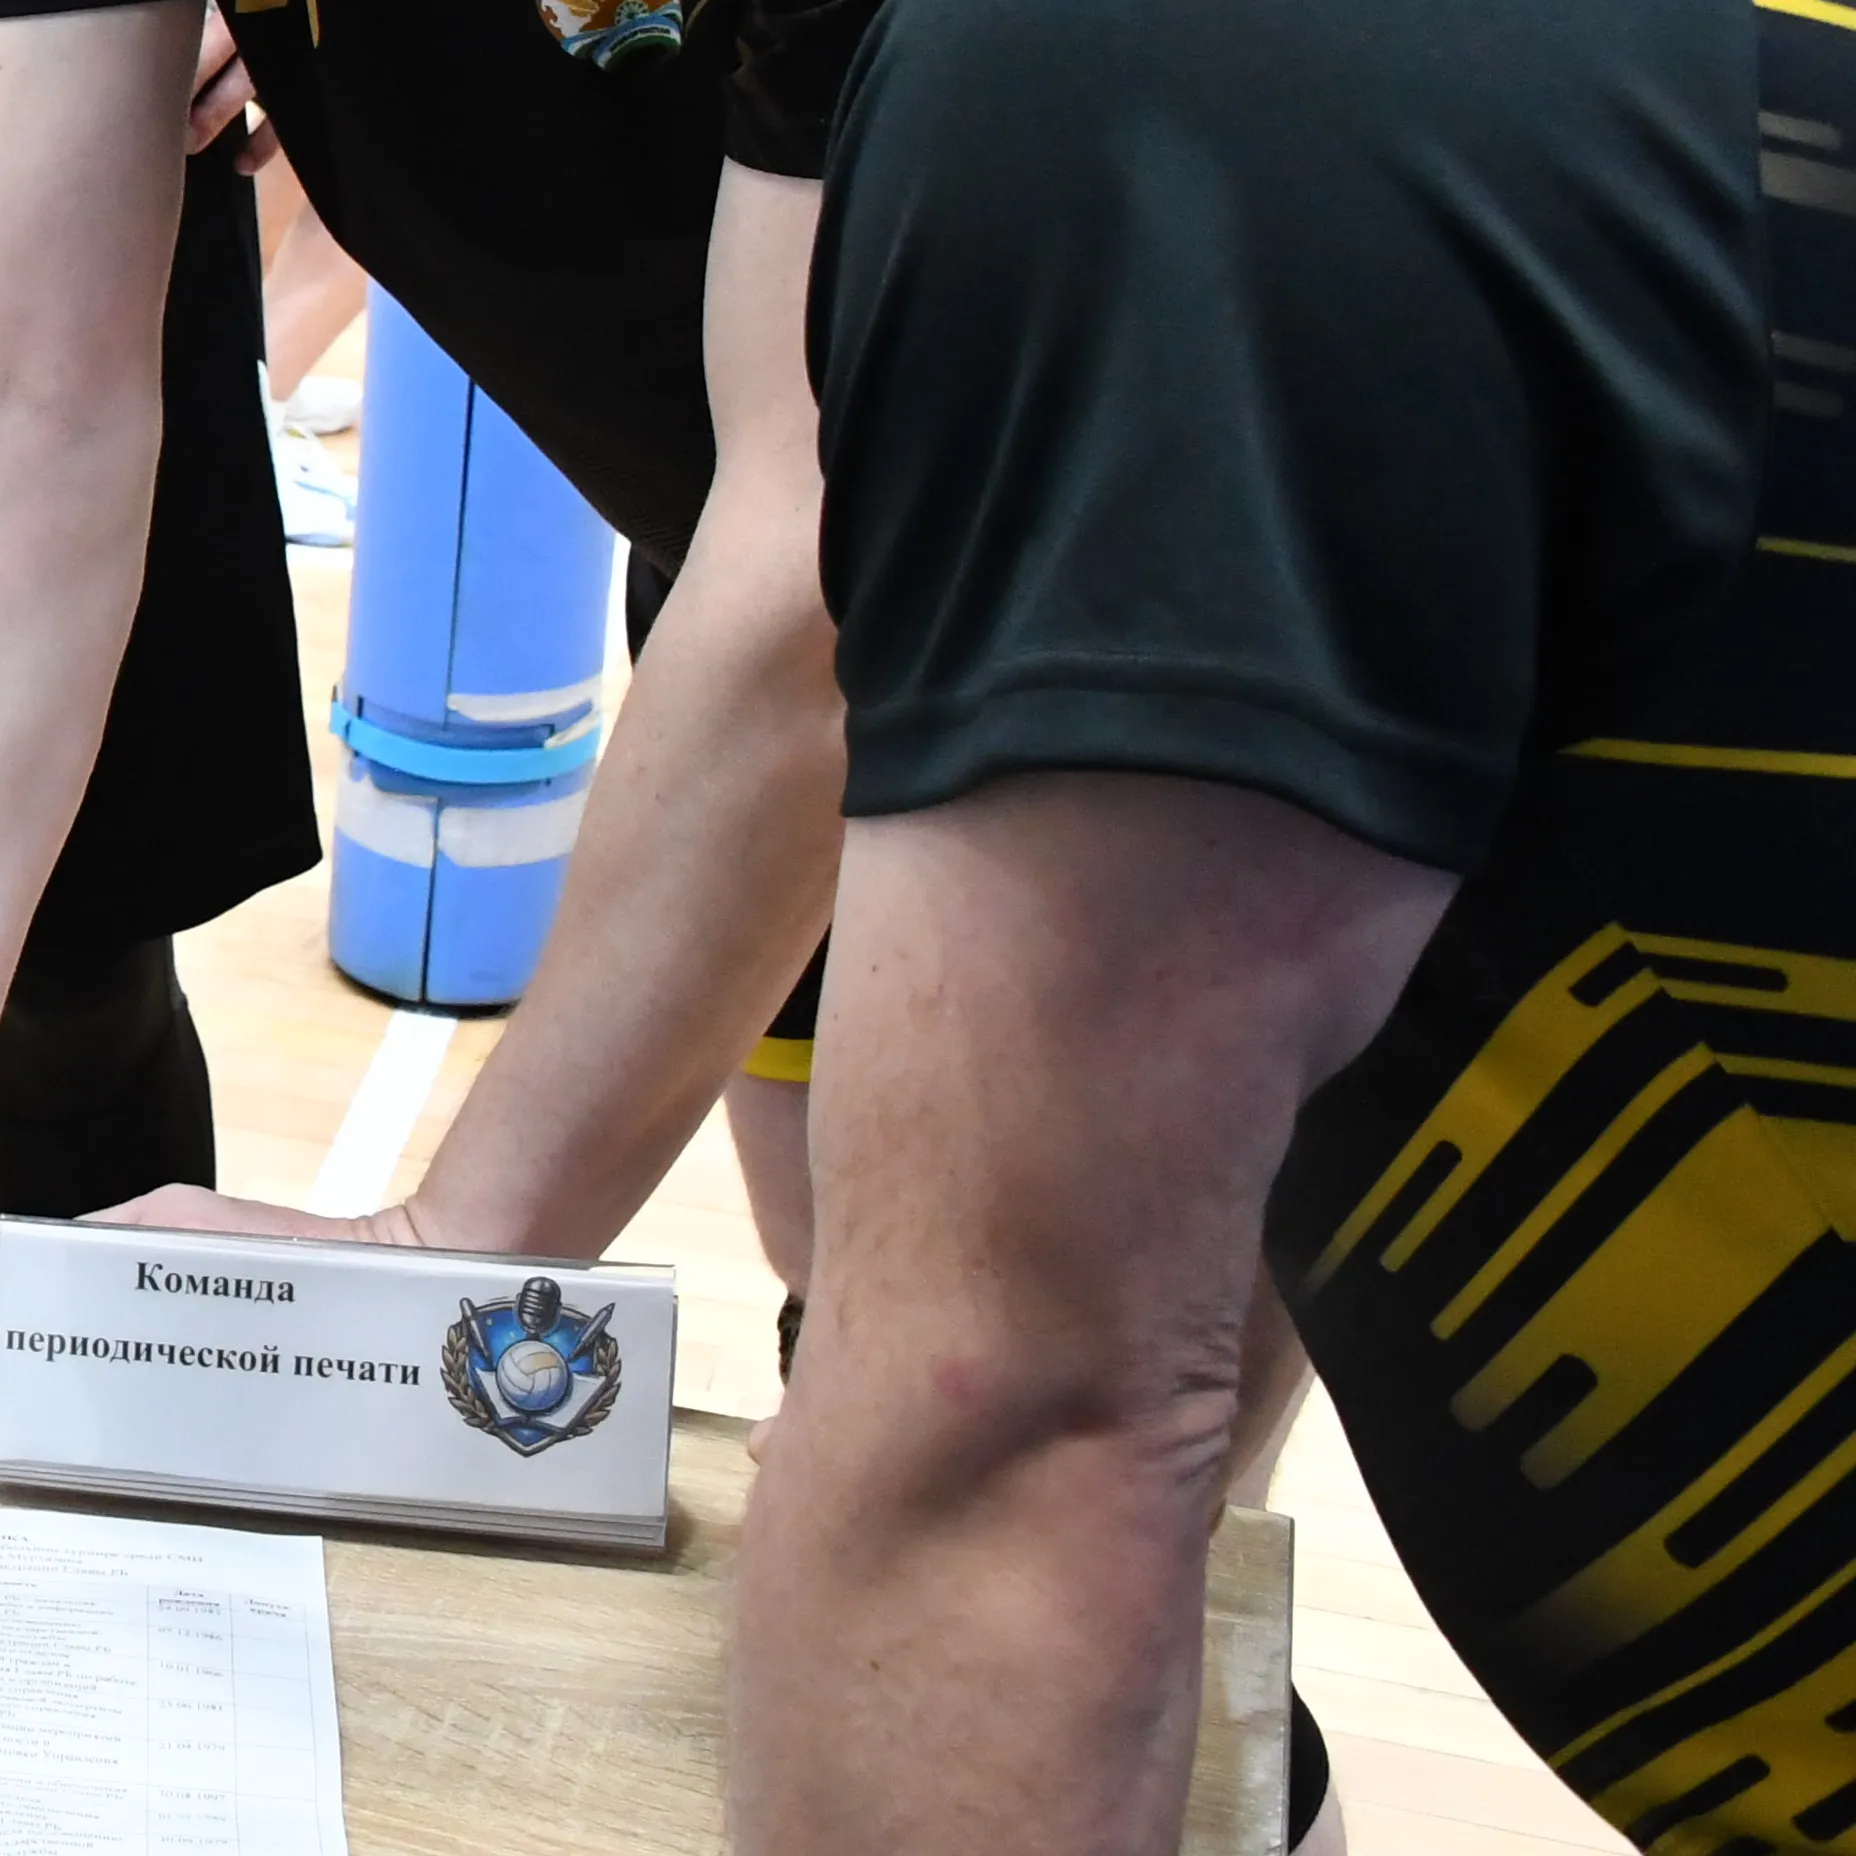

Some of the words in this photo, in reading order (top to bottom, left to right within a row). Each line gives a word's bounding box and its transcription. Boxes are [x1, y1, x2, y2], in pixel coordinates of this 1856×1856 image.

[134, 1261, 295, 1304] Команда
[5, 1326, 280, 1376] периодической
[292, 1355, 422, 1388] печати
